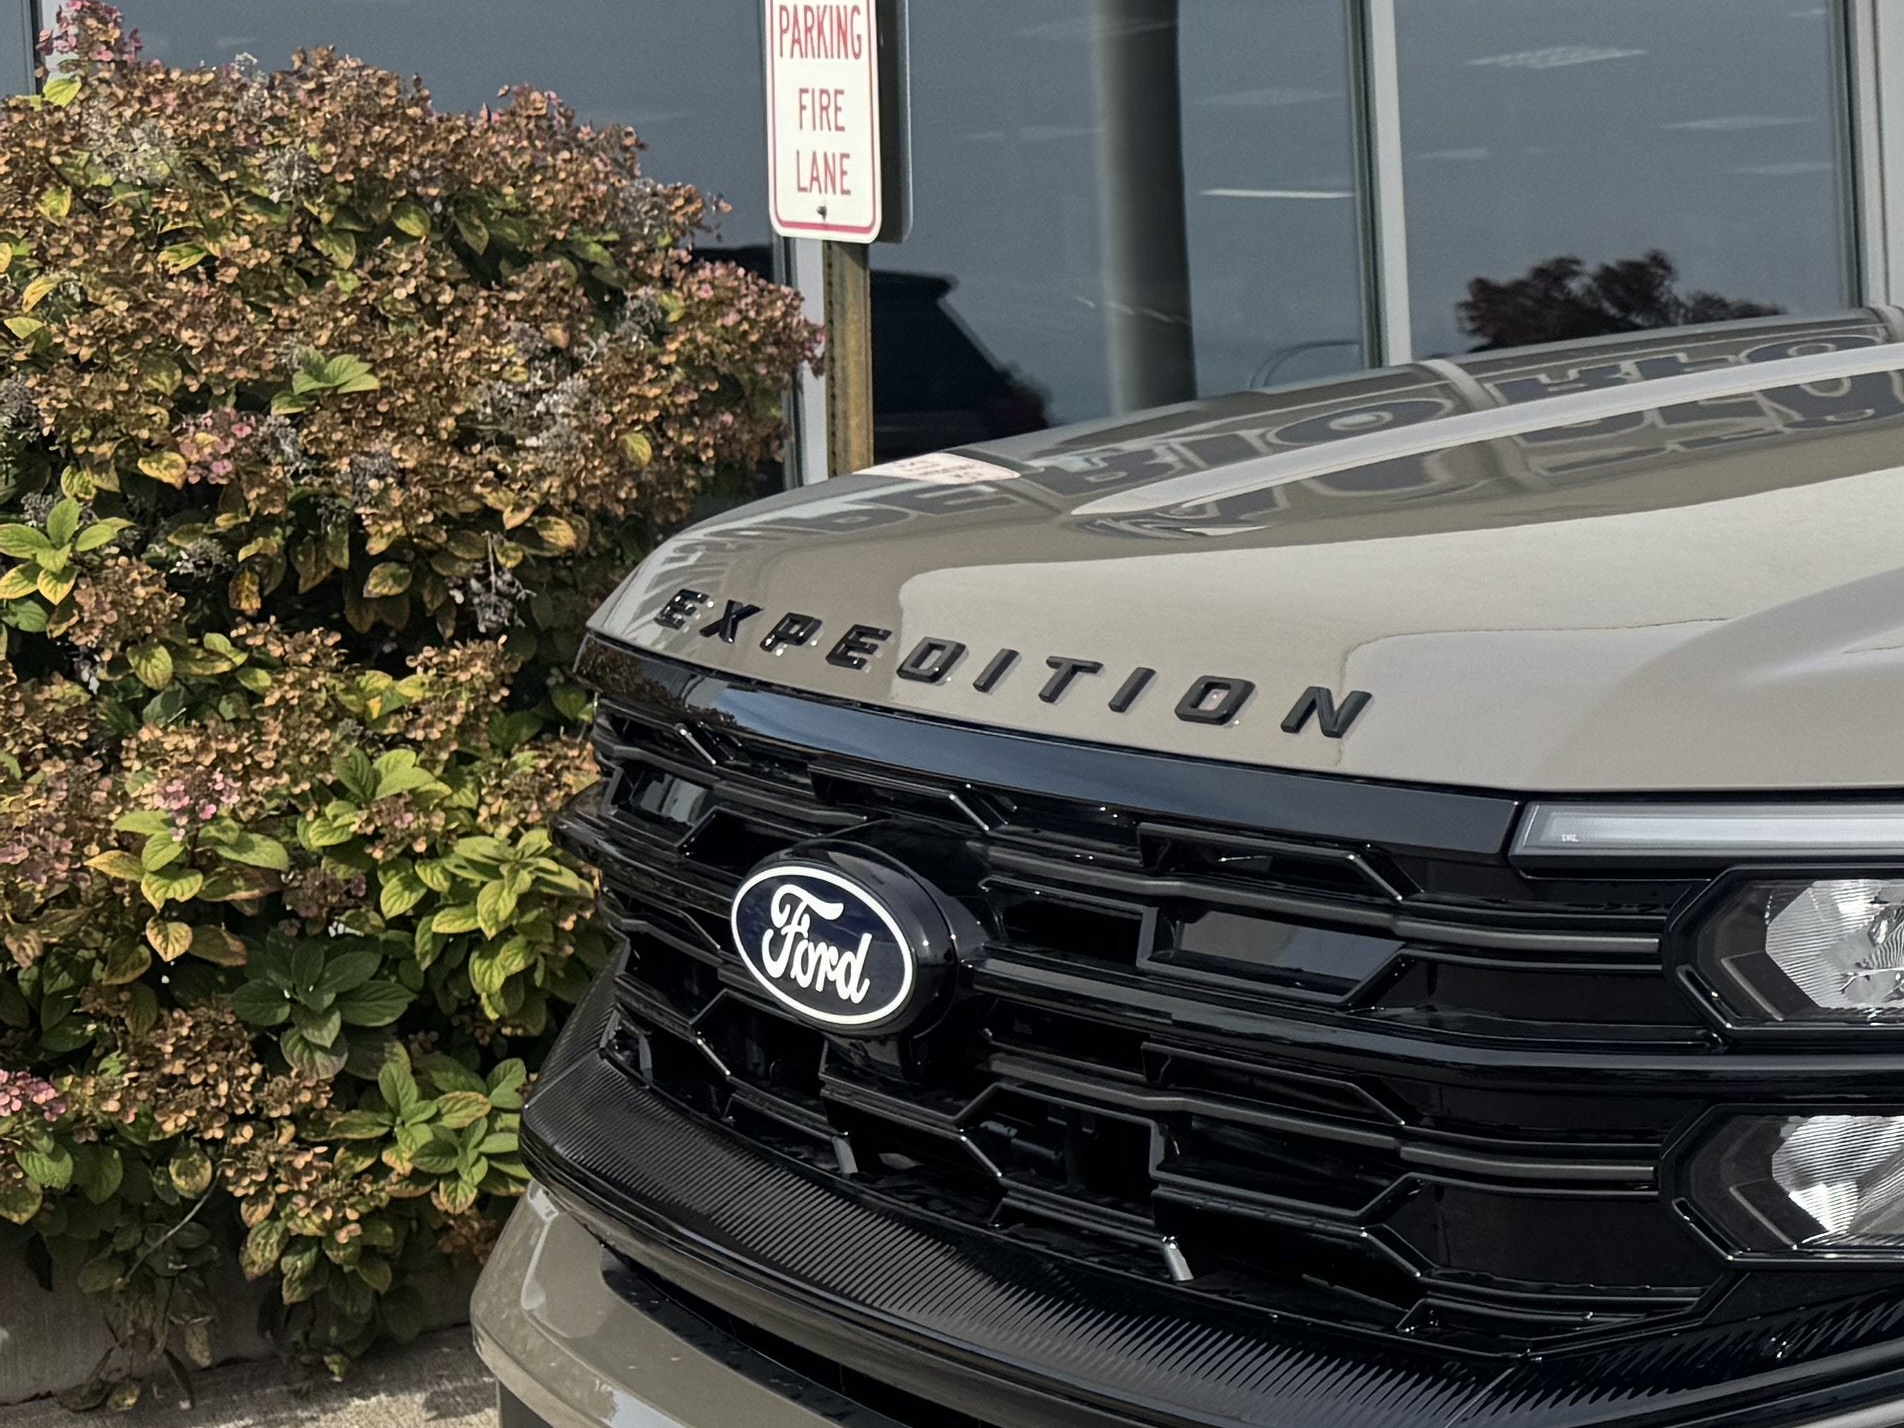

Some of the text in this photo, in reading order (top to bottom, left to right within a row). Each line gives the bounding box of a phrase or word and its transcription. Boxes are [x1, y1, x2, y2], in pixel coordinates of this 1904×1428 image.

[779, 4, 862, 61] PARKING
[798, 88, 846, 132] FIRE
[796, 150, 852, 196] LANE
[653, 588, 1375, 740] EXPEDITION
[762, 883, 873, 1004] Ford
